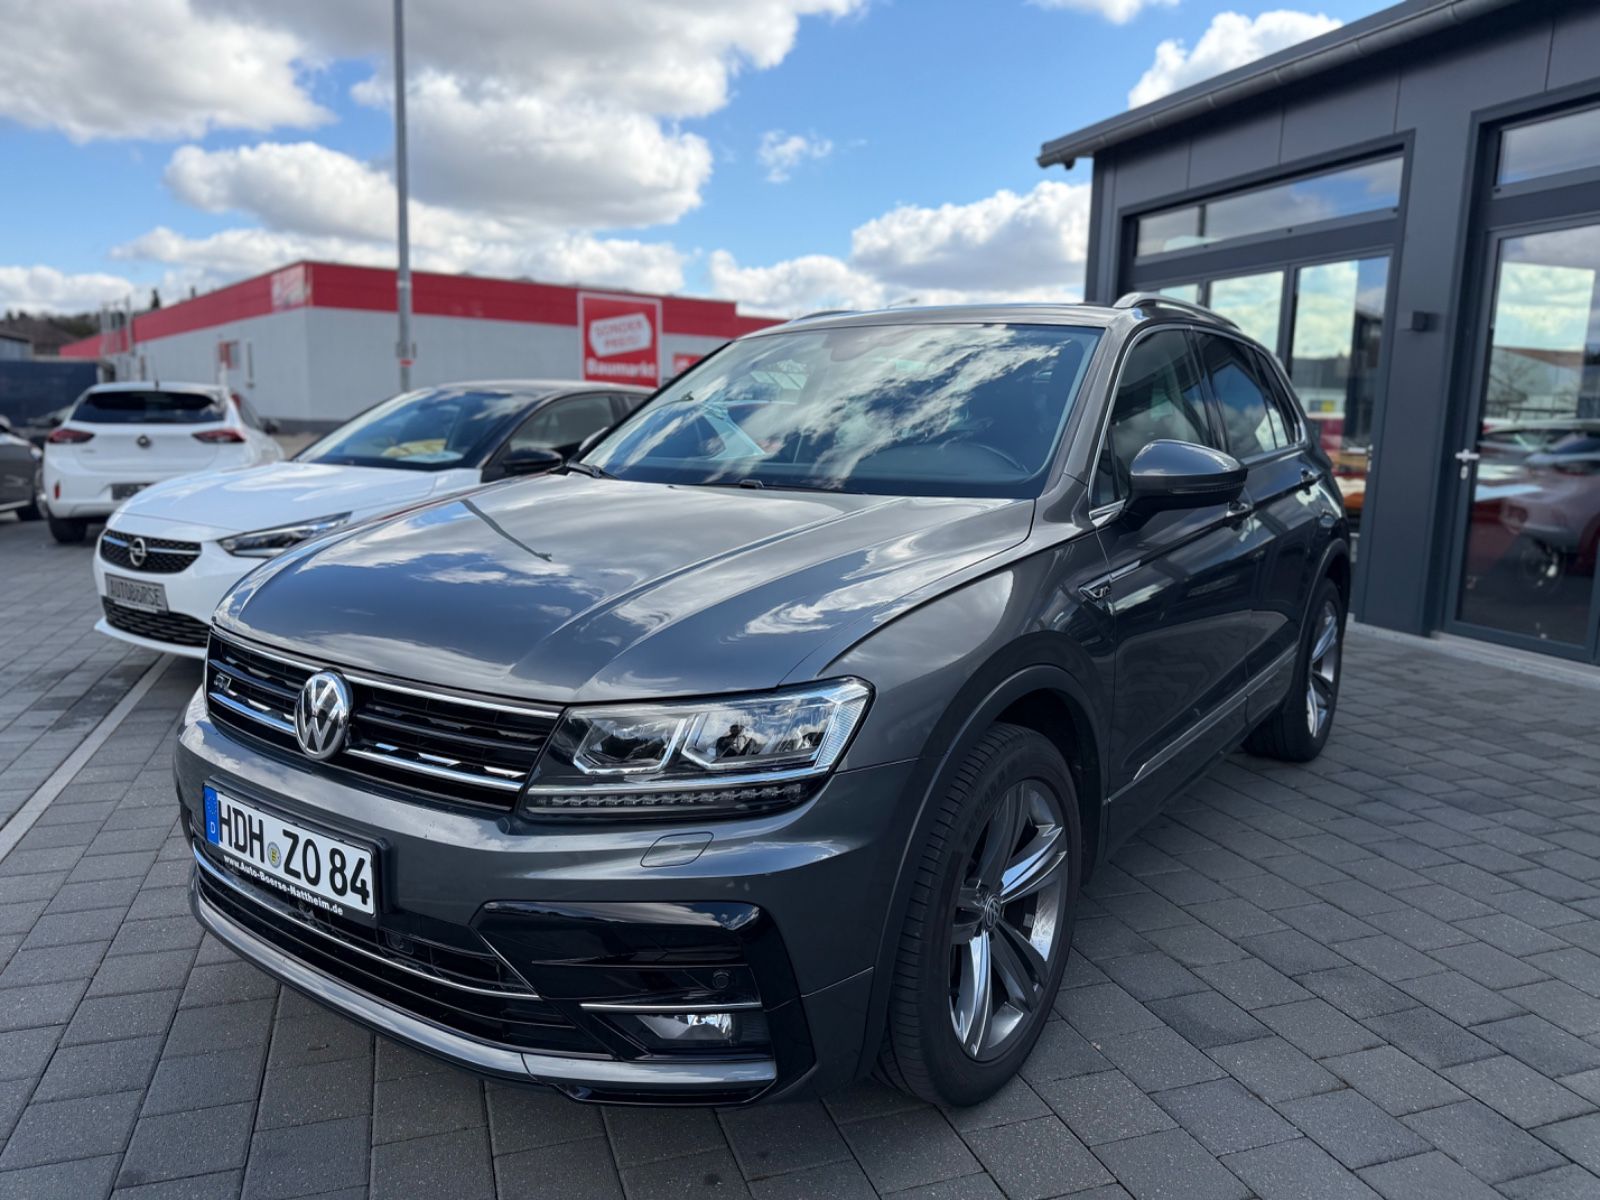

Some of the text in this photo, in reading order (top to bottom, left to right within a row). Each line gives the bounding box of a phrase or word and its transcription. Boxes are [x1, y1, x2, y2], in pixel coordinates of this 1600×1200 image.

[587, 358, 656, 377] Baumarkt
[210, 821, 216, 834] D
[219, 800, 370, 905] HDH ZO 84
